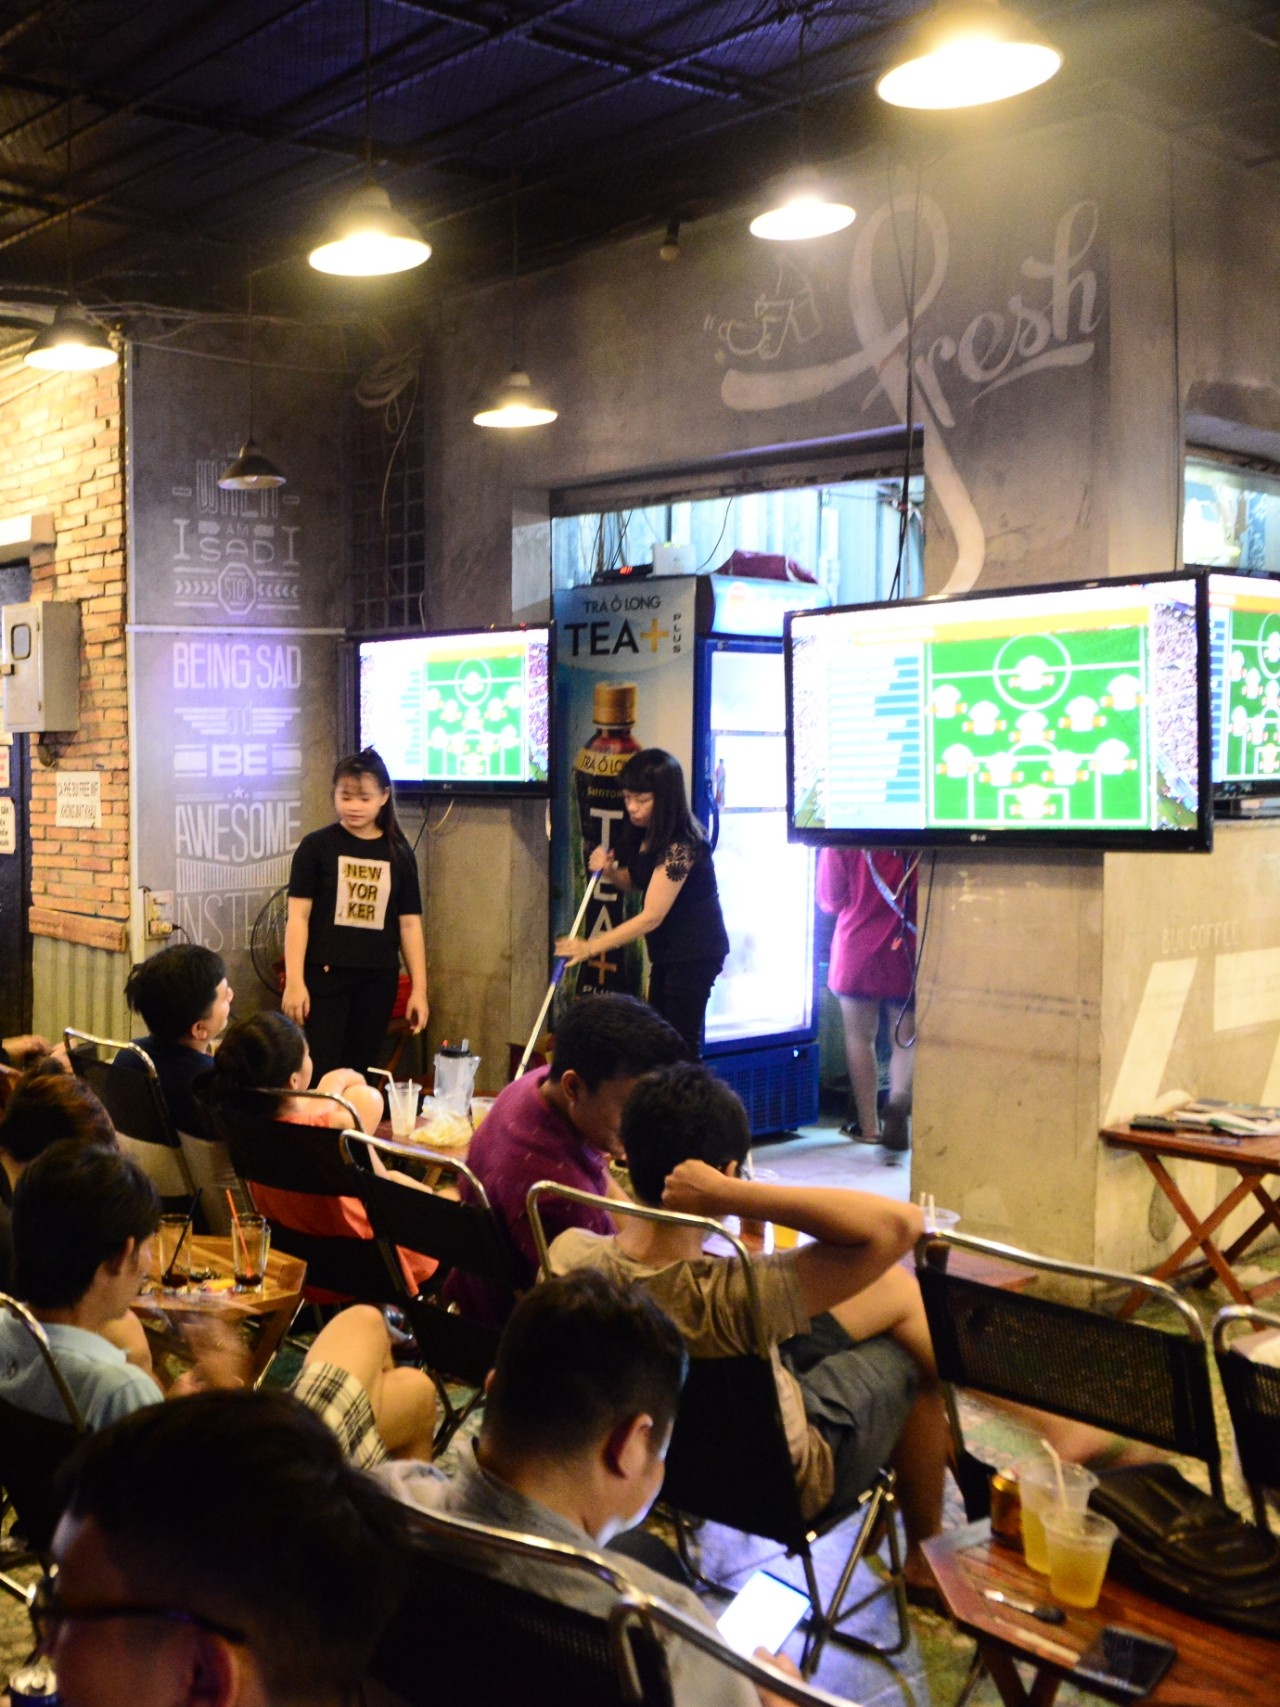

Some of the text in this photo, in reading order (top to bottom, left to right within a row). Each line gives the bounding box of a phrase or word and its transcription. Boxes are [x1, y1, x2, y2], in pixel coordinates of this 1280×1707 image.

[226, 523, 249, 536] AM
[199, 537, 275, 564] SAD
[225, 577, 250, 601] STOP
[625, 595, 661, 611] LONG
[673, 613, 682, 653] PLUS
[173, 642, 302, 689] BEING SAD
[211, 743, 267, 777] BE
[175, 801, 301, 864] AWESOME
[345, 864, 382, 880] NEW
[348, 882, 378, 901] YOR
[177, 889, 289, 951] INSTEA
[347, 903, 375, 920] KER
